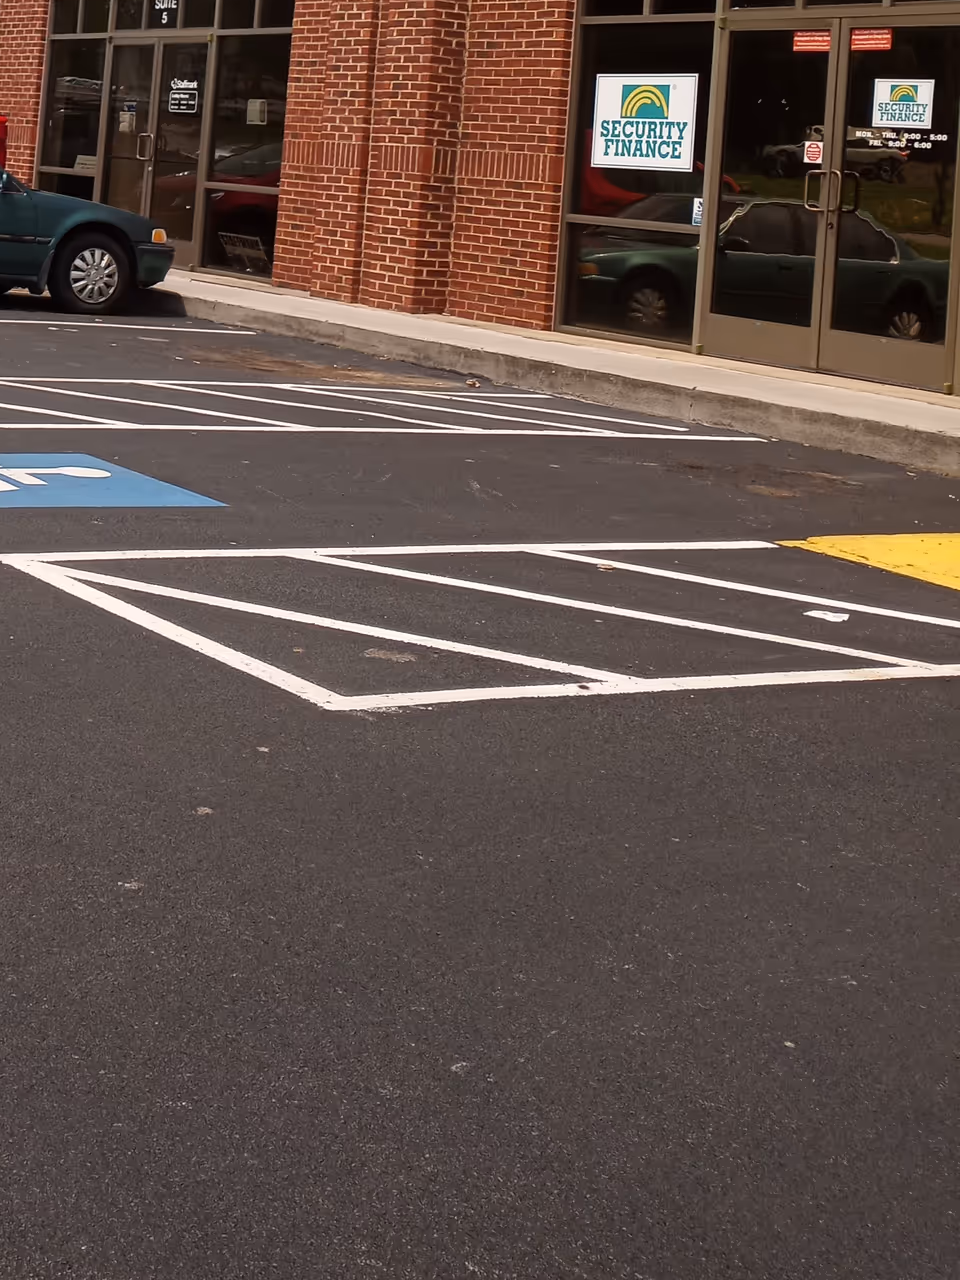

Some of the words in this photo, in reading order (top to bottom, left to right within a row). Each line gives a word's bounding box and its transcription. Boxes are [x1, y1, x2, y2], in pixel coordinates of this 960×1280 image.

[161, 11, 169, 25] 5
[877, 102, 928, 113] SECURITY
[879, 112, 925, 123] FINANCE
[600, 120, 688, 140] SECURITY
[603, 139, 682, 159] FINANCE
